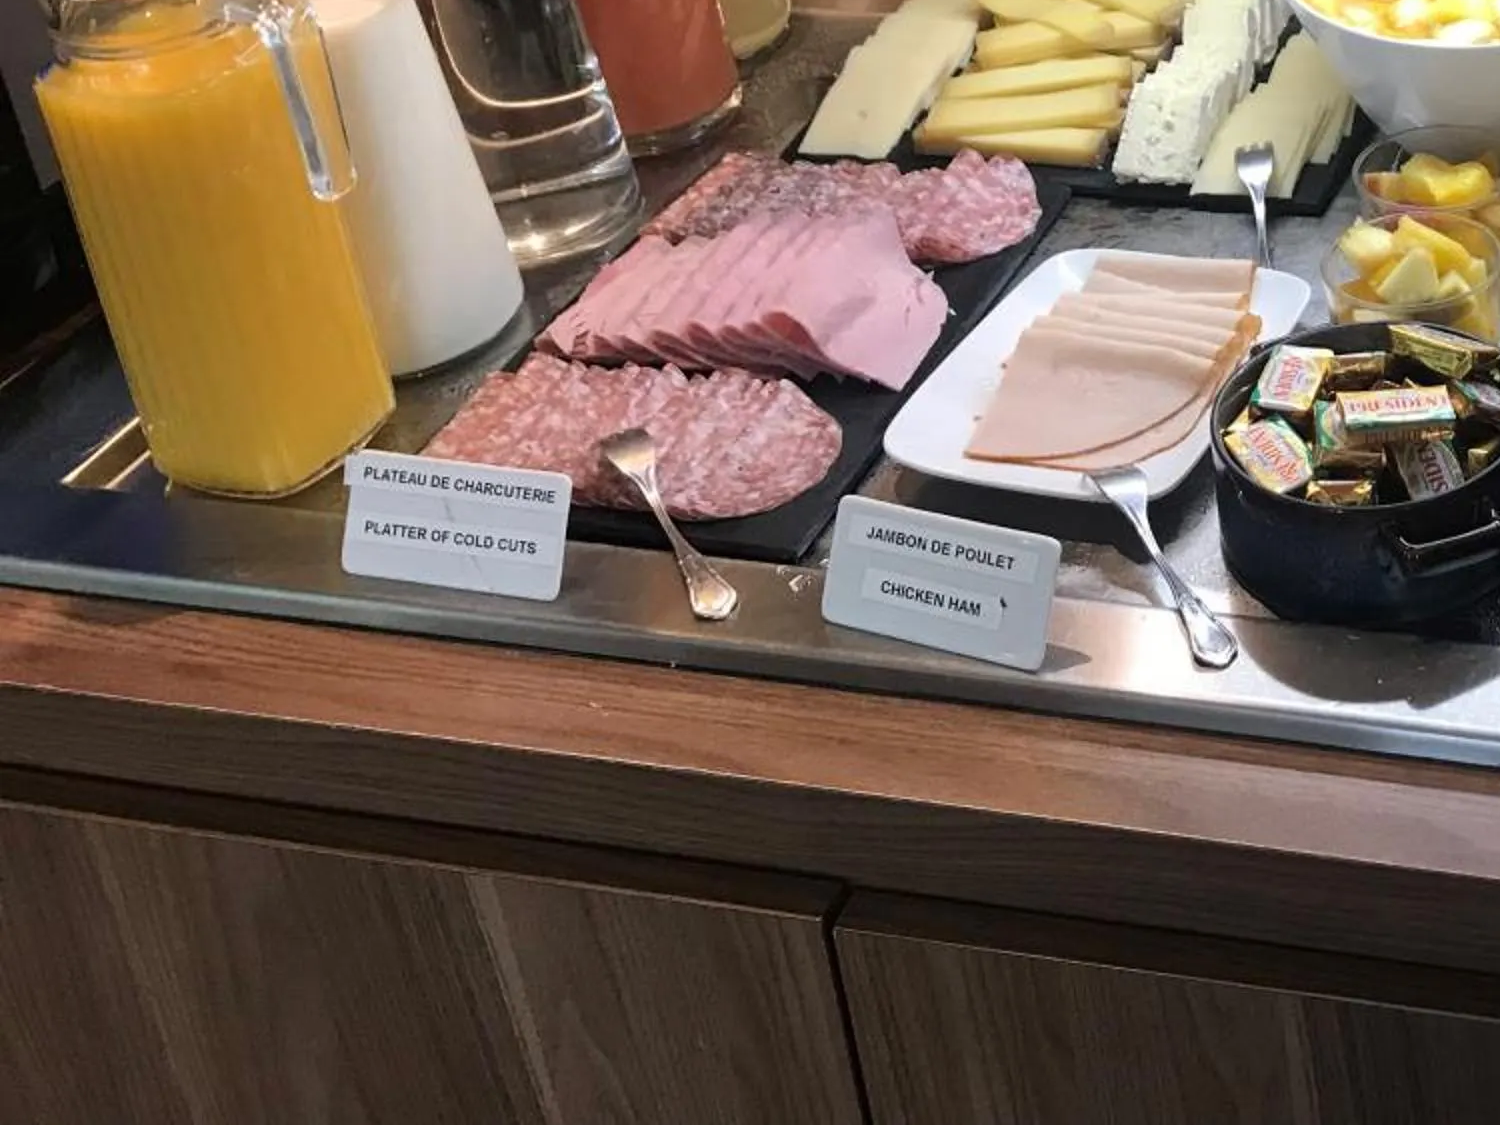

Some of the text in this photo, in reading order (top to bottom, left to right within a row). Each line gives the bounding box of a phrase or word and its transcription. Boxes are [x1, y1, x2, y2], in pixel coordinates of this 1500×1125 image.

[363, 466, 557, 504] PLATEAU DE CHARCUTERIE
[363, 520, 537, 555] PLATTER OF COLD CUTS
[866, 526, 1016, 570] JAMBON DE POULET
[880, 580, 981, 617] CHICKEN HAM
